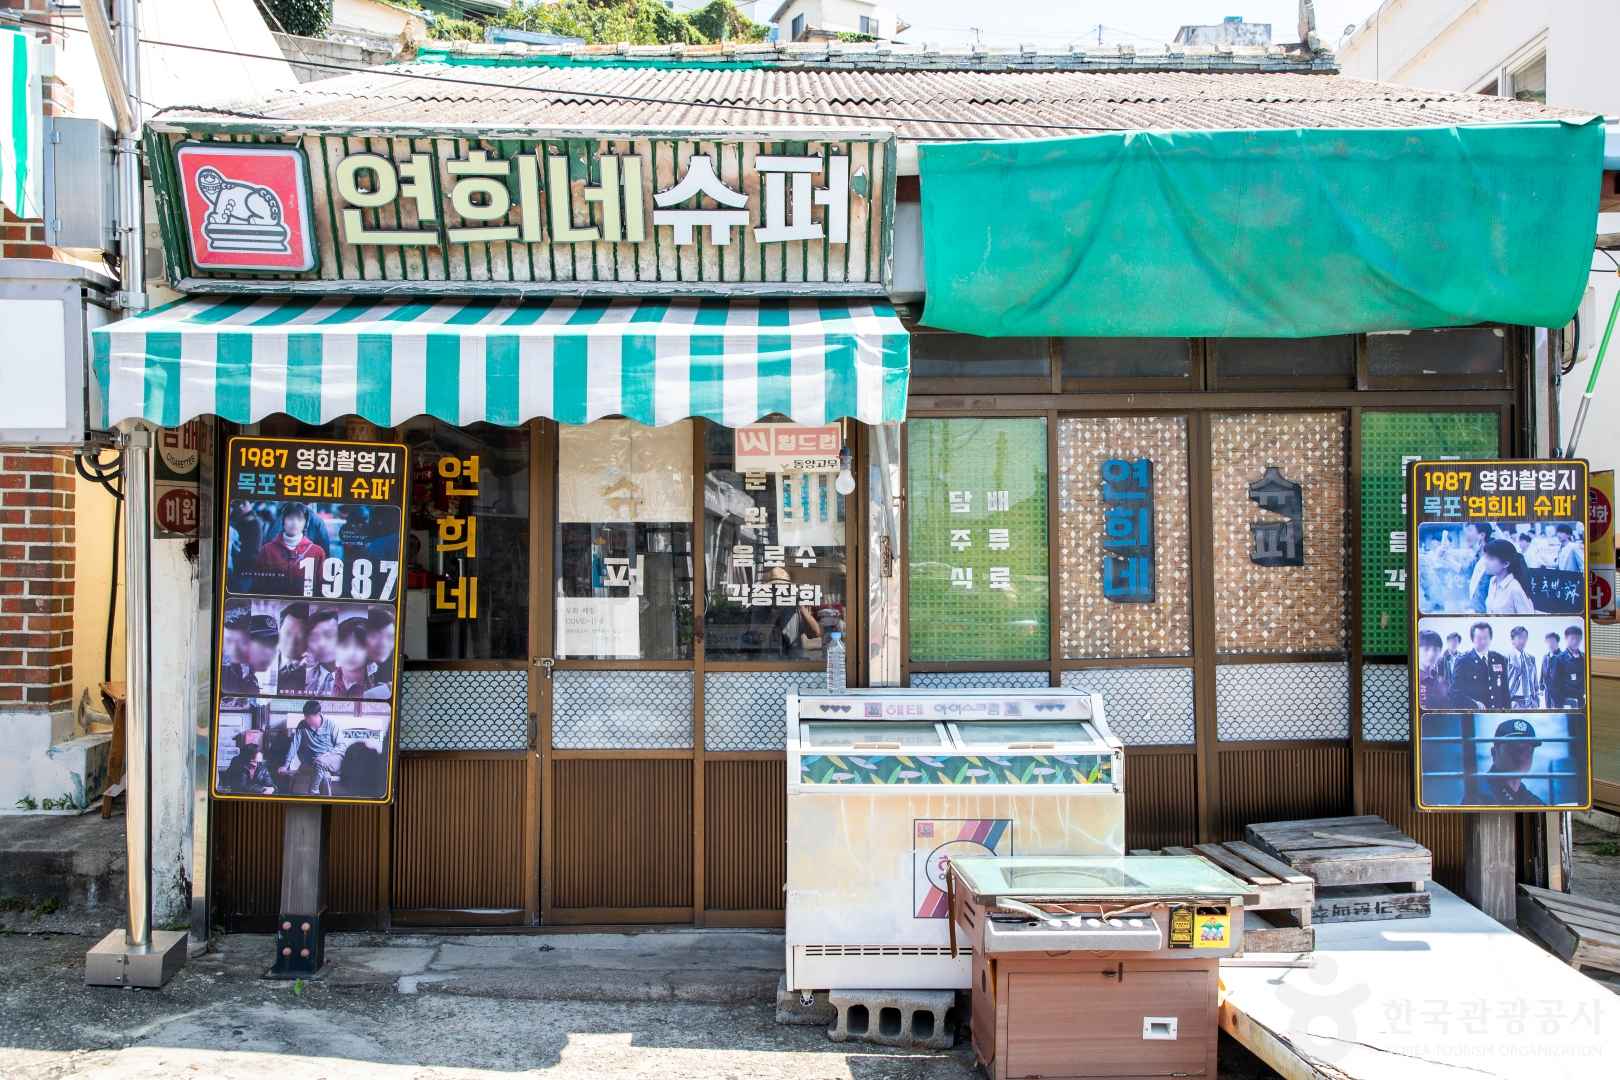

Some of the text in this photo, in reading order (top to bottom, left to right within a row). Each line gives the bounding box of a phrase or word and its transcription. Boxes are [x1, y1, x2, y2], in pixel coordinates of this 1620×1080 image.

[335, 152, 850, 246] 연희네 슈퍼
[239, 447, 396, 474] 1987 영화촬영지
[237, 472, 277, 495] 목포
[1423, 470, 1577, 492] 1987 영화촬영지
[165, 497, 197, 526] 미원
[1423, 496, 1463, 517] 목포
[436, 456, 480, 618] 연희네
[1102, 458, 1153, 597] 연희네
[299, 556, 399, 601] 1987
